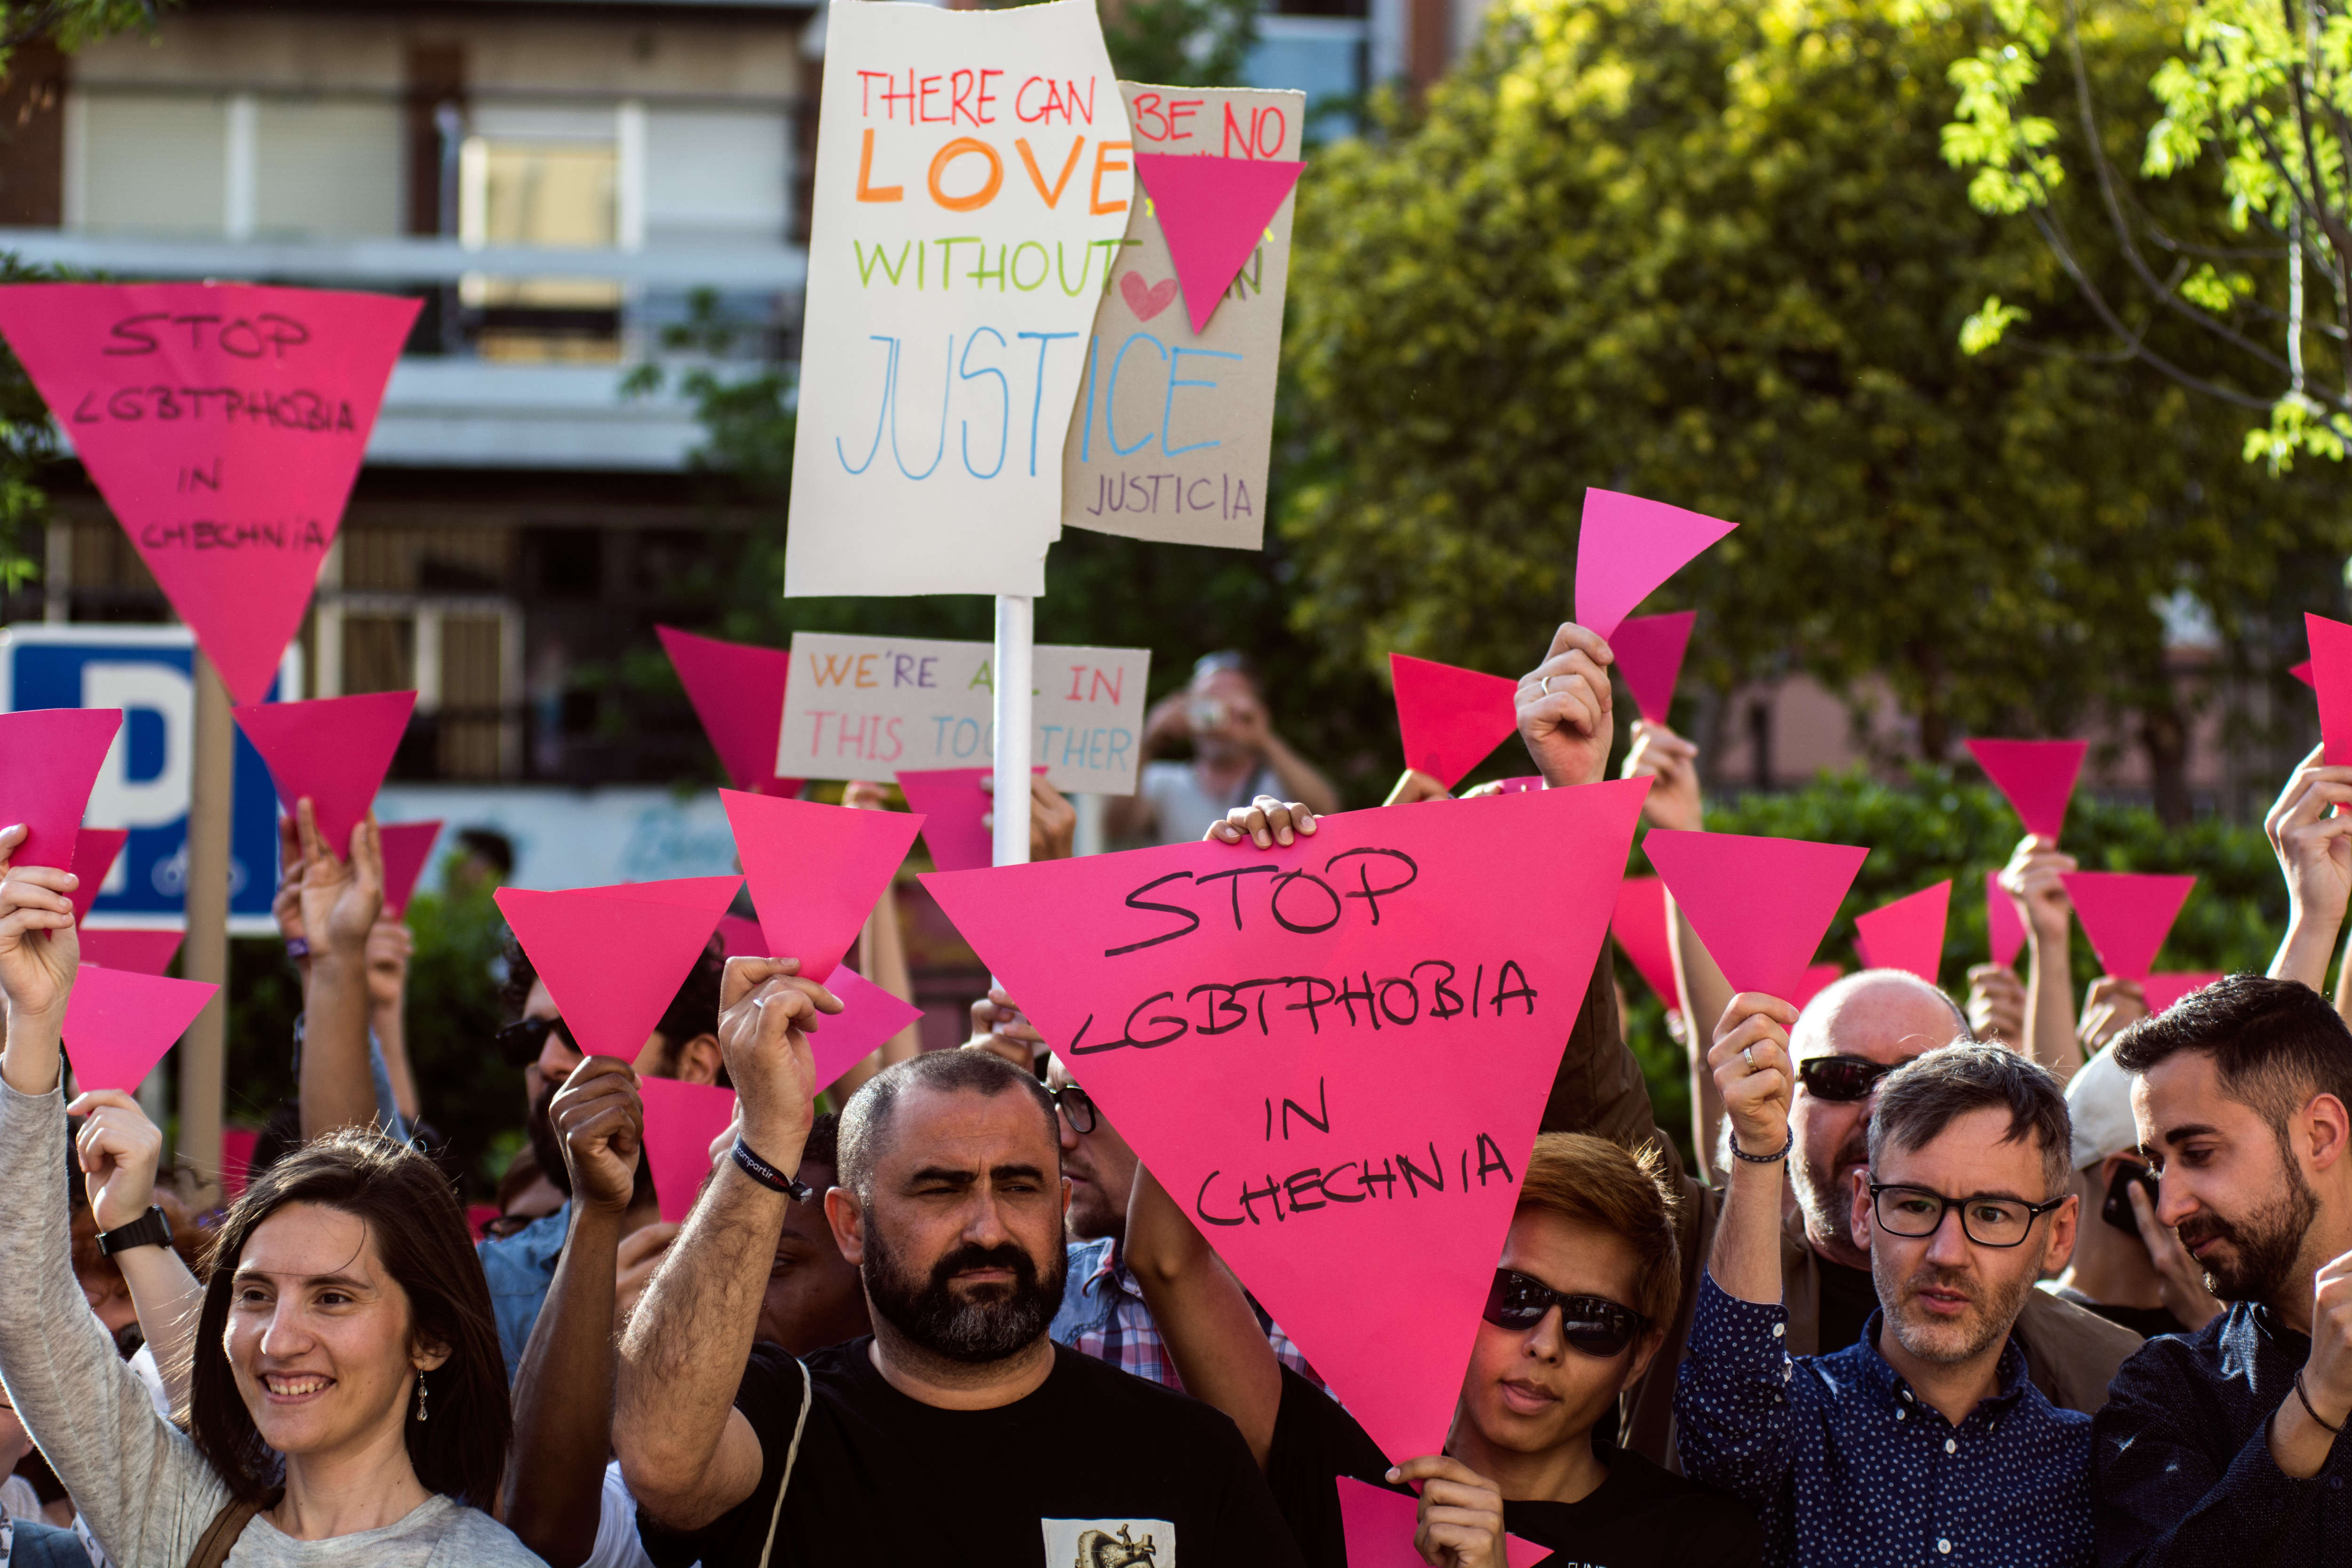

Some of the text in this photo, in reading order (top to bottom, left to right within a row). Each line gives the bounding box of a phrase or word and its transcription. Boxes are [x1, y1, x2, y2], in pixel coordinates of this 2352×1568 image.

[856, 67, 1286, 160] THERE CAN BE NO
[855, 128, 1133, 216] LOVE
[853, 236, 1144, 297] WITHOUT
[101, 312, 310, 359] STOP
[72, 384, 357, 433] LGBTPHOBIA
[836, 326, 1243, 480] JUSTICE
[178, 459, 222, 493] IN
[1087, 472, 1252, 519] JUSTICIA
[810, 650, 938, 688] WE'RE
[1065, 666, 1122, 705] IN
[805, 710, 903, 762] THIS
[81, 661, 193, 895] P
[1104, 847, 1418, 957] STOP
[1069, 959, 1538, 1055] LGBTPHOBIA
[1264, 1076, 1330, 1142] IN
[1196, 1132, 1513, 1226] CHECHNIA
